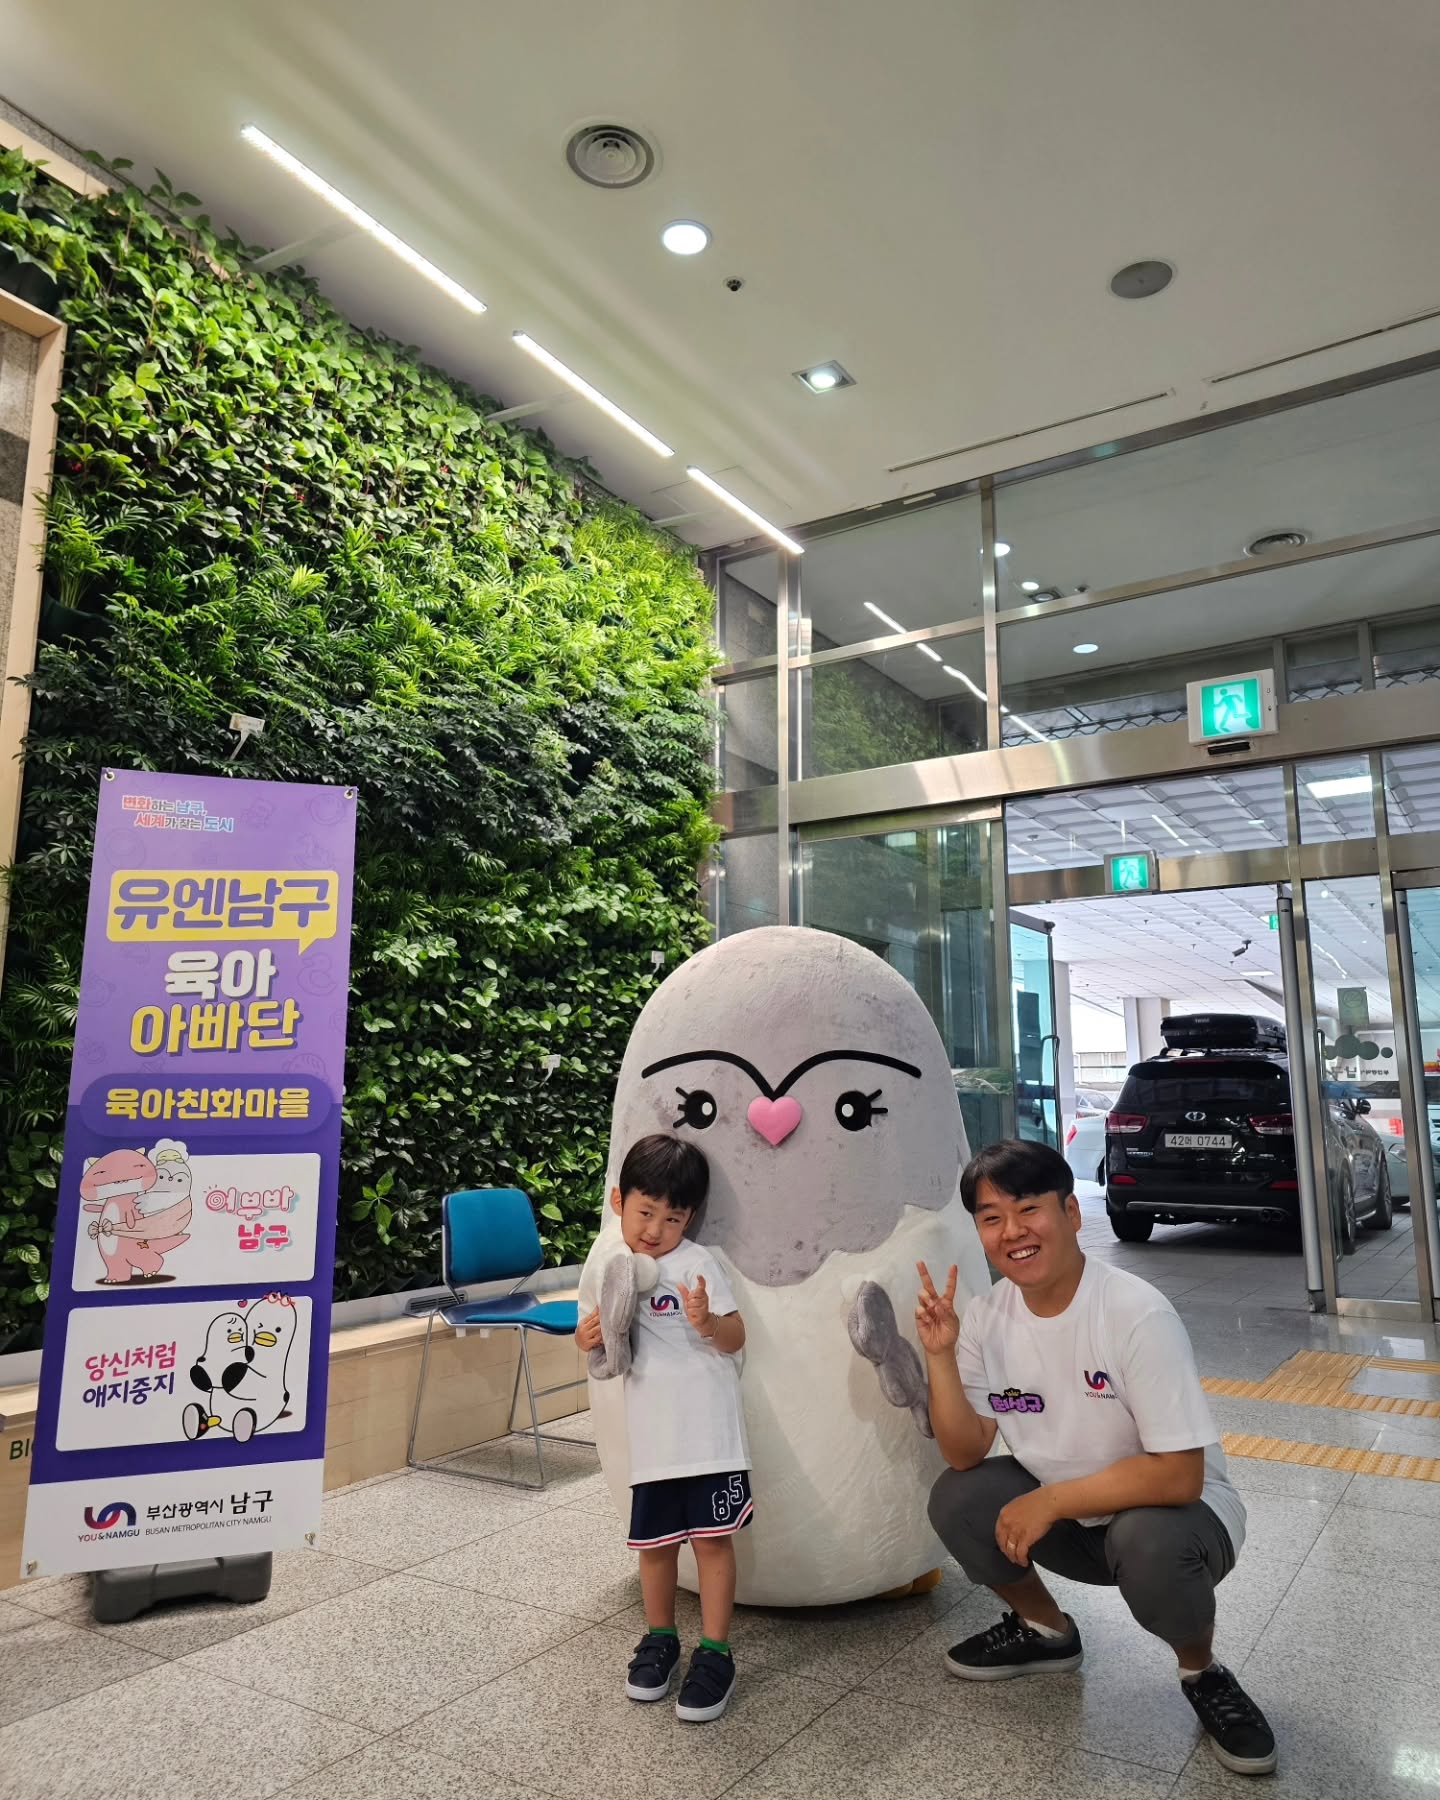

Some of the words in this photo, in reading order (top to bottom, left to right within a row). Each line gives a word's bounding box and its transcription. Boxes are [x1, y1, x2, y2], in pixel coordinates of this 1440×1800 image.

[122, 795, 176, 813] 변화하는
[175, 799, 208, 816] 남구,
[134, 812, 177, 829] 세계가
[177, 817, 202, 831] 찾는
[203, 815, 235, 833] 도시
[114, 877, 330, 930] 유엔남구
[165, 948, 277, 1000] 육아
[130, 998, 301, 1055] 아빠단
[105, 1087, 310, 1120] 육아친화마을
[1197, 1135, 1226, 1146] 0744
[205, 1186, 295, 1221] 어부바
[238, 1223, 290, 1250] 남구
[85, 1341, 176, 1382] 당신처럼
[82, 1371, 175, 1408] 애지중지
[9, 1438, 33, 1460] BI
[146, 1498, 224, 1521] 부산광역시
[230, 1490, 274, 1515] 남구
[78, 1528, 140, 1543] YOU&NAMGU
[145, 1526, 171, 1536] BUSAN
[171, 1520, 225, 1534] METROPOLITAN
[226, 1518, 242, 1528] CITY
[242, 1515, 272, 1526] NAMGU
